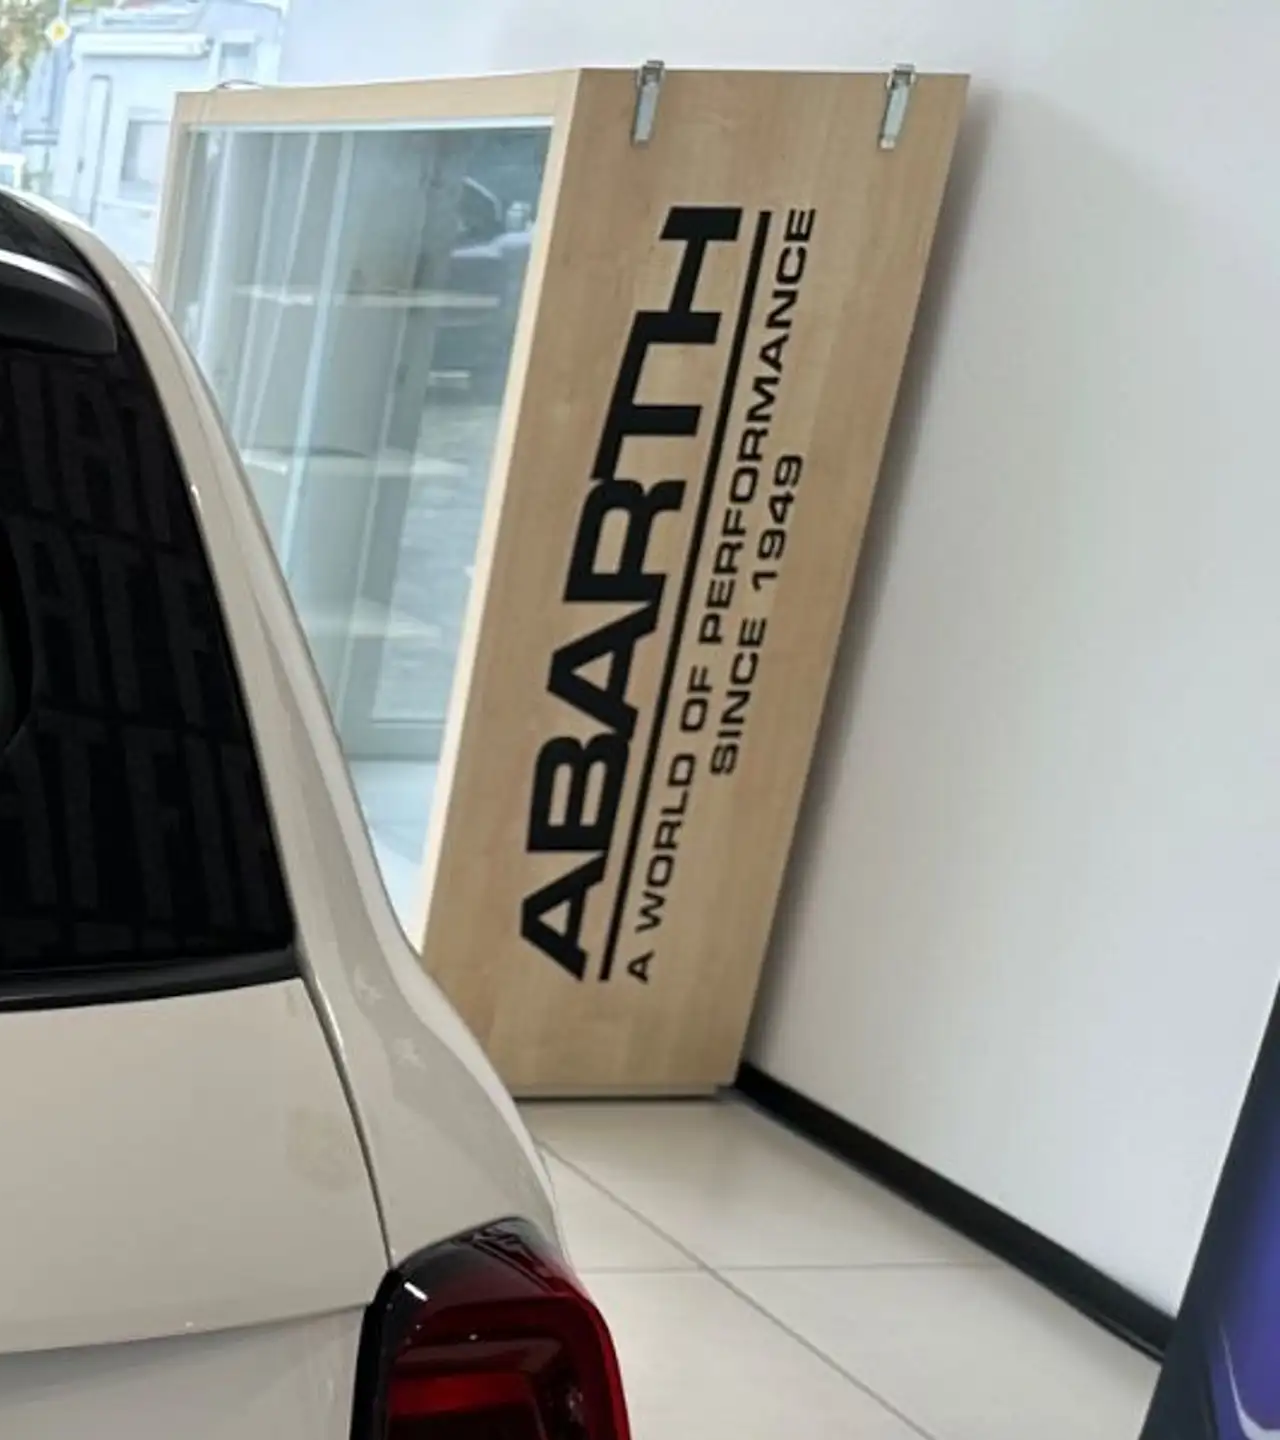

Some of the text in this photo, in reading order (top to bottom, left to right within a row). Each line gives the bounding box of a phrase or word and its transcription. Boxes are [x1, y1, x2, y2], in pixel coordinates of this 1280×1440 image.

[520, 206, 743, 982] ABARTH
[626, 208, 816, 984] A WORLD OF PERFORMANCE
[710, 454, 803, 775] SINCE 1949
